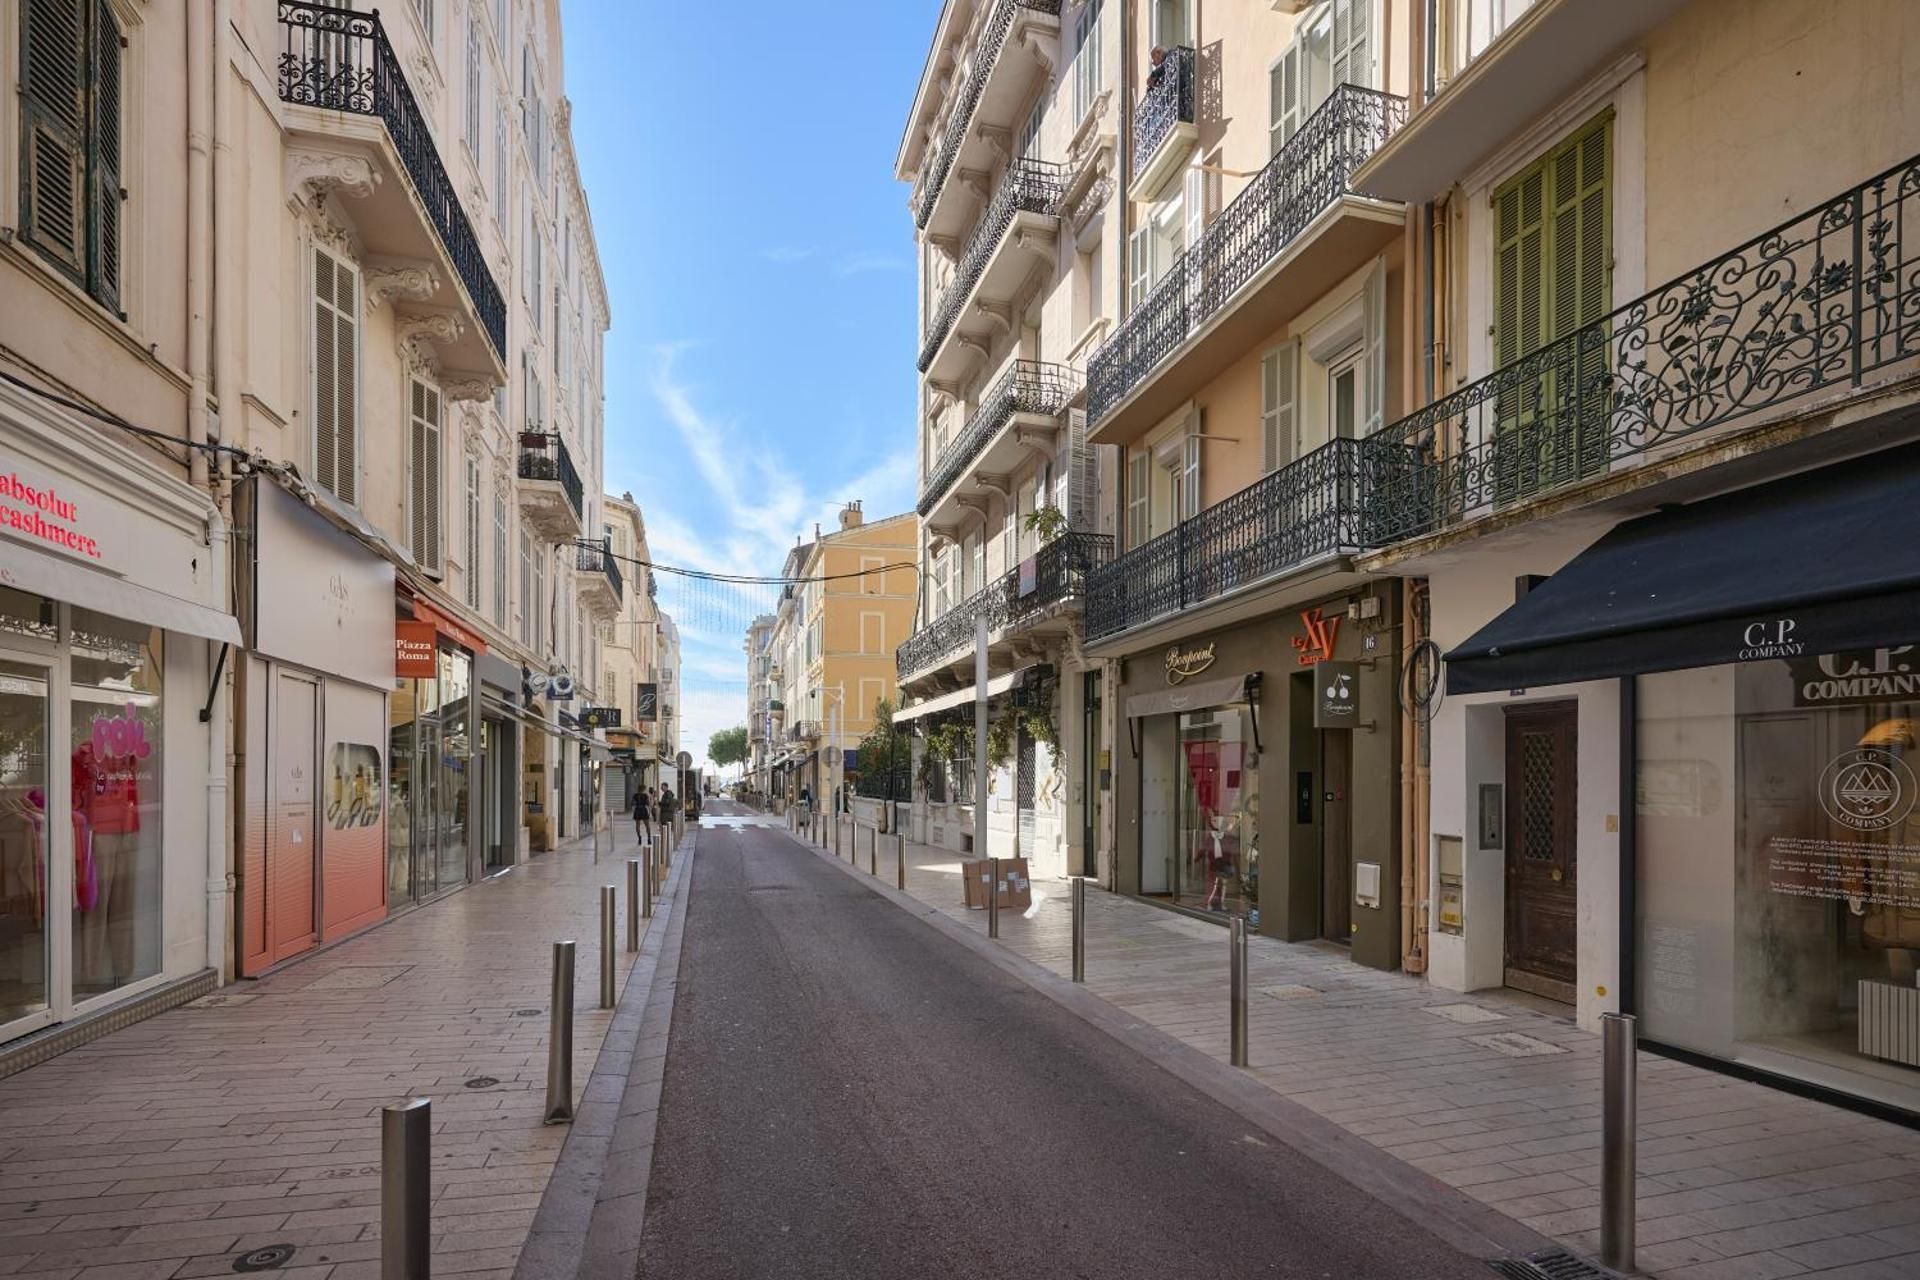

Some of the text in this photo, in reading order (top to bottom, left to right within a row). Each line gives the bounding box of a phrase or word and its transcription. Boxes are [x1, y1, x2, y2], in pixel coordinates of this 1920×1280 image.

[0, 473, 77, 522] absolut
[0, 505, 101, 558] cashmere.
[1300, 607, 1341, 660] XV
[1743, 618, 1796, 647] C.P.
[396, 639, 432, 650] Piazza
[1365, 636, 1375, 649] 16
[1738, 642, 1805, 660] COMPANY
[397, 650, 430, 660] Roma
[1855, 752, 1877, 762] C.P.
[1839, 812, 1893, 828] COMPANY
